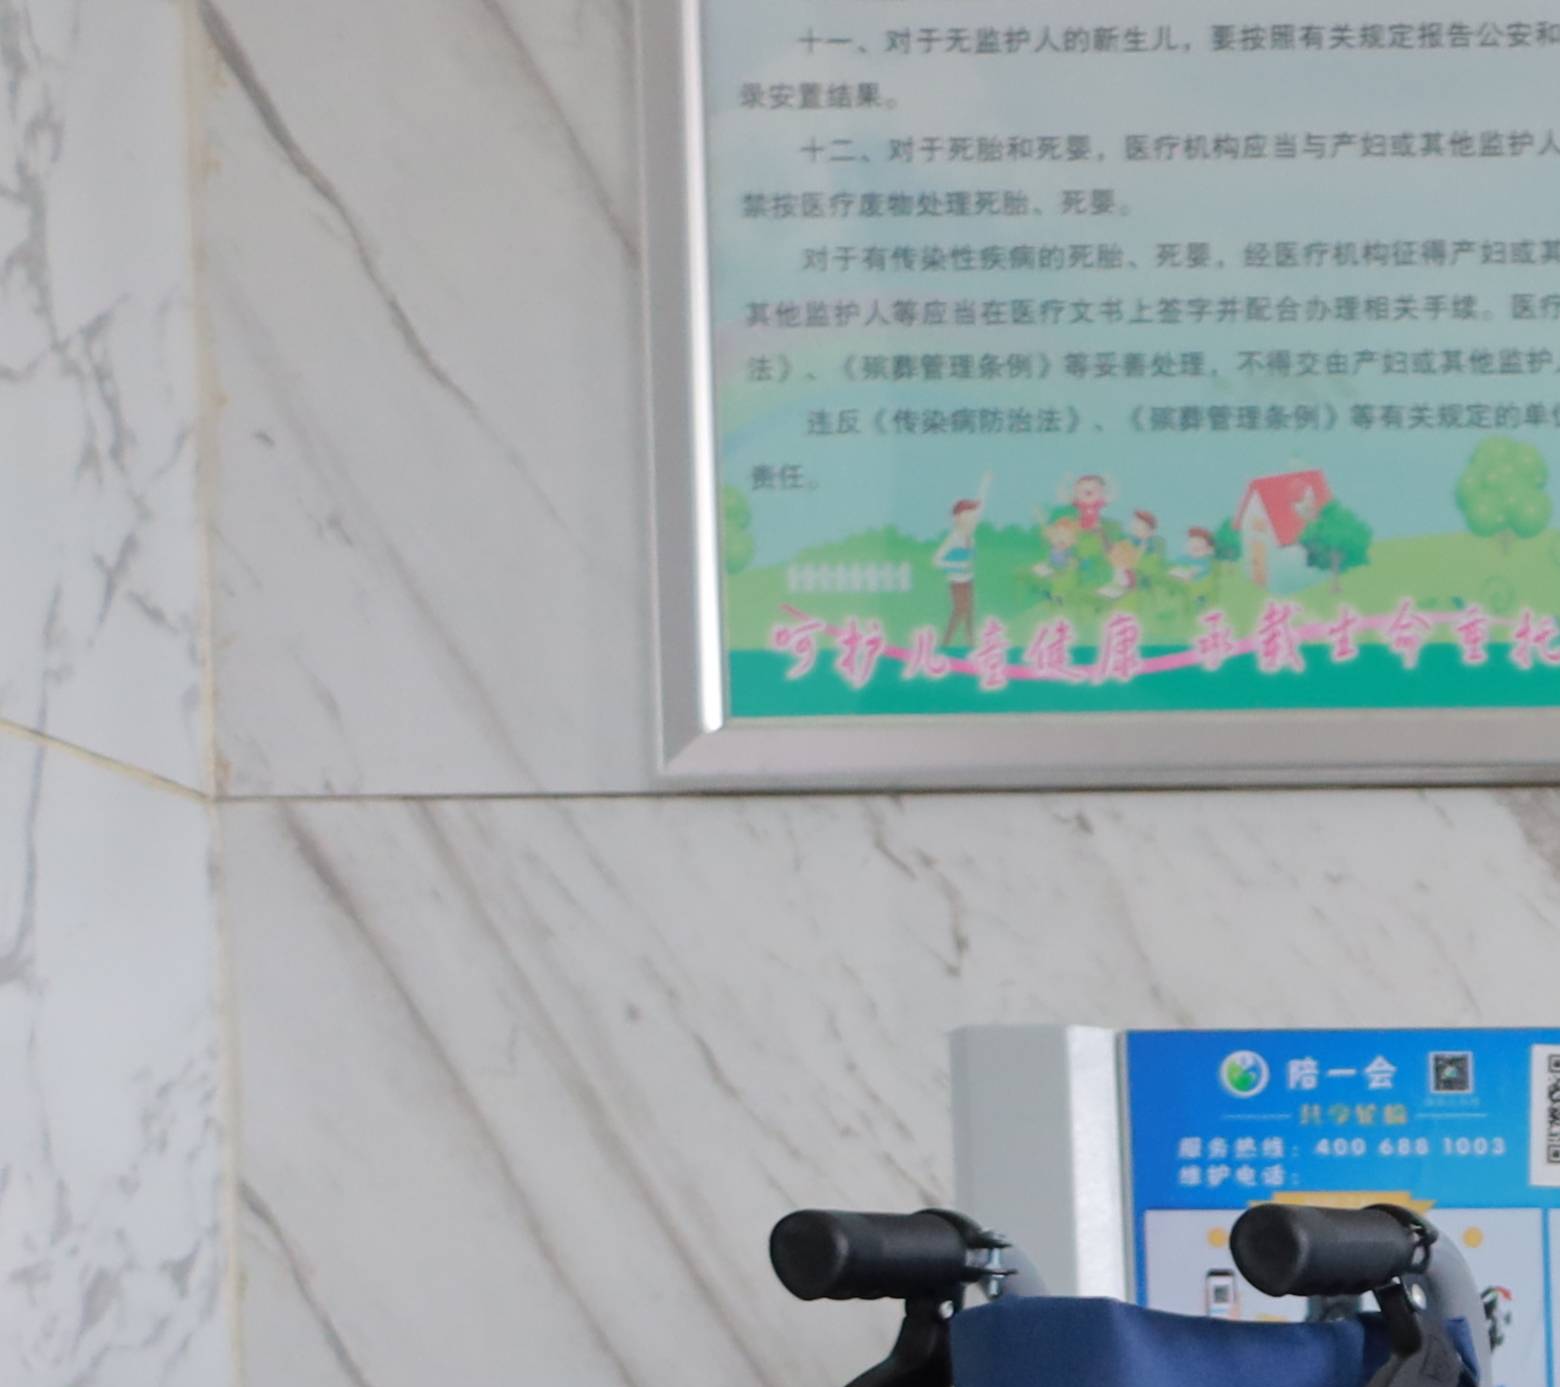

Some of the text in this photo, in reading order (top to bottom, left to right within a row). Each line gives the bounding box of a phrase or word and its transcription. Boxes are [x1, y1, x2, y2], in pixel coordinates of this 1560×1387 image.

[750, 464, 820, 492] 责任。
[1286, 1055, 1398, 1091] 陪一会
